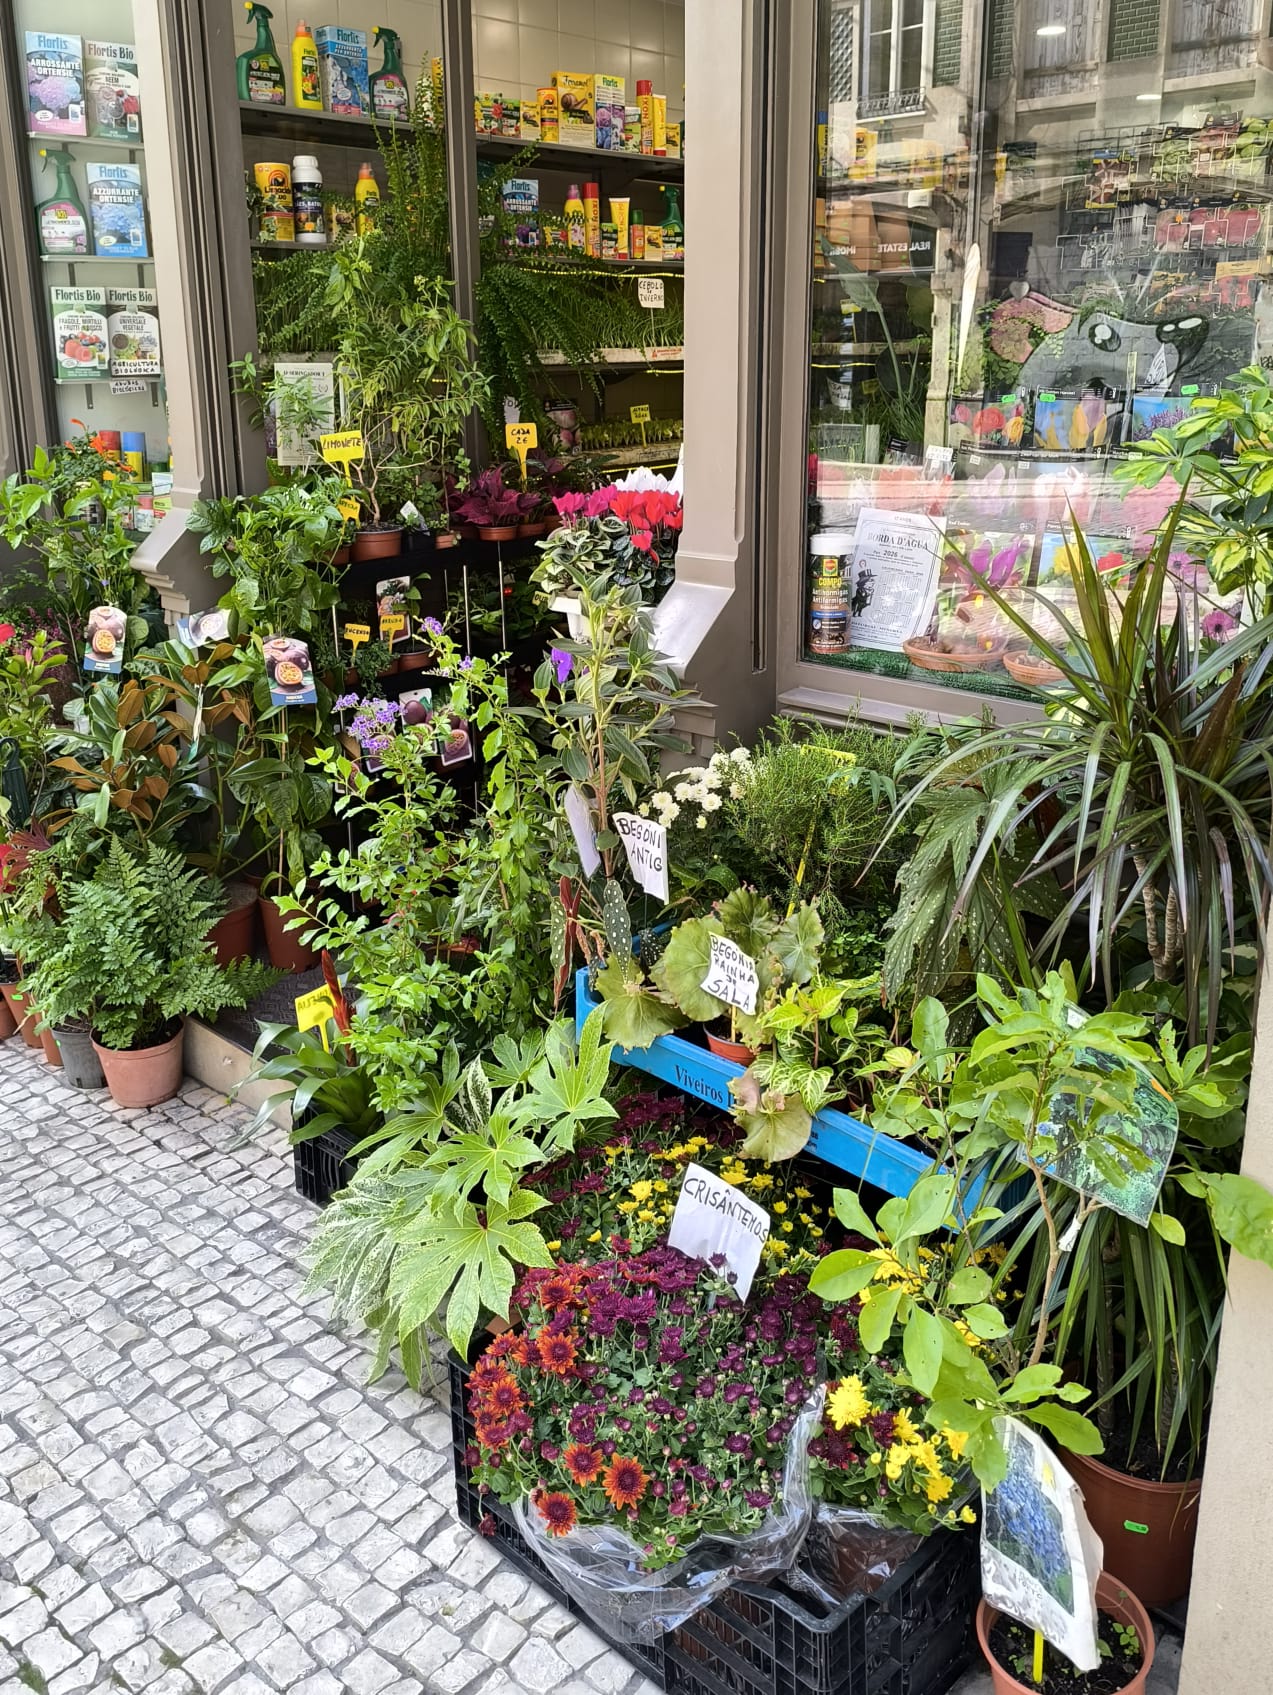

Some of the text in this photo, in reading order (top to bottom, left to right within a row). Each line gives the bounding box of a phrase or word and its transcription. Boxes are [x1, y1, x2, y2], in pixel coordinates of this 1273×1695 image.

[37, 35, 68, 50] Flortis
[337, 29, 360, 44] Flortis
[88, 44, 134, 60] Flortis Bio
[30, 59, 81, 70] ARROSSANTE
[37, 67, 74, 77] ORTENSIE
[99, 166, 128, 178] Flortis
[93, 187, 139, 196] AZZURRANTE
[99, 195, 134, 203] ORTENSIE
[55, 289, 101, 301] Flortis Bio
[109, 290, 153, 302] Flortis Bio
[510, 428, 531, 436] CADA
[322, 437, 362, 449] LIMONETE
[819, 578, 842, 588] COMPO
[714, 953, 755, 984] RAINHA
[707, 979, 750, 1010] SALA
[674, 1064, 723, 1104] Viveiros
[683, 1177, 770, 1243] CRISÂNTEMOS
